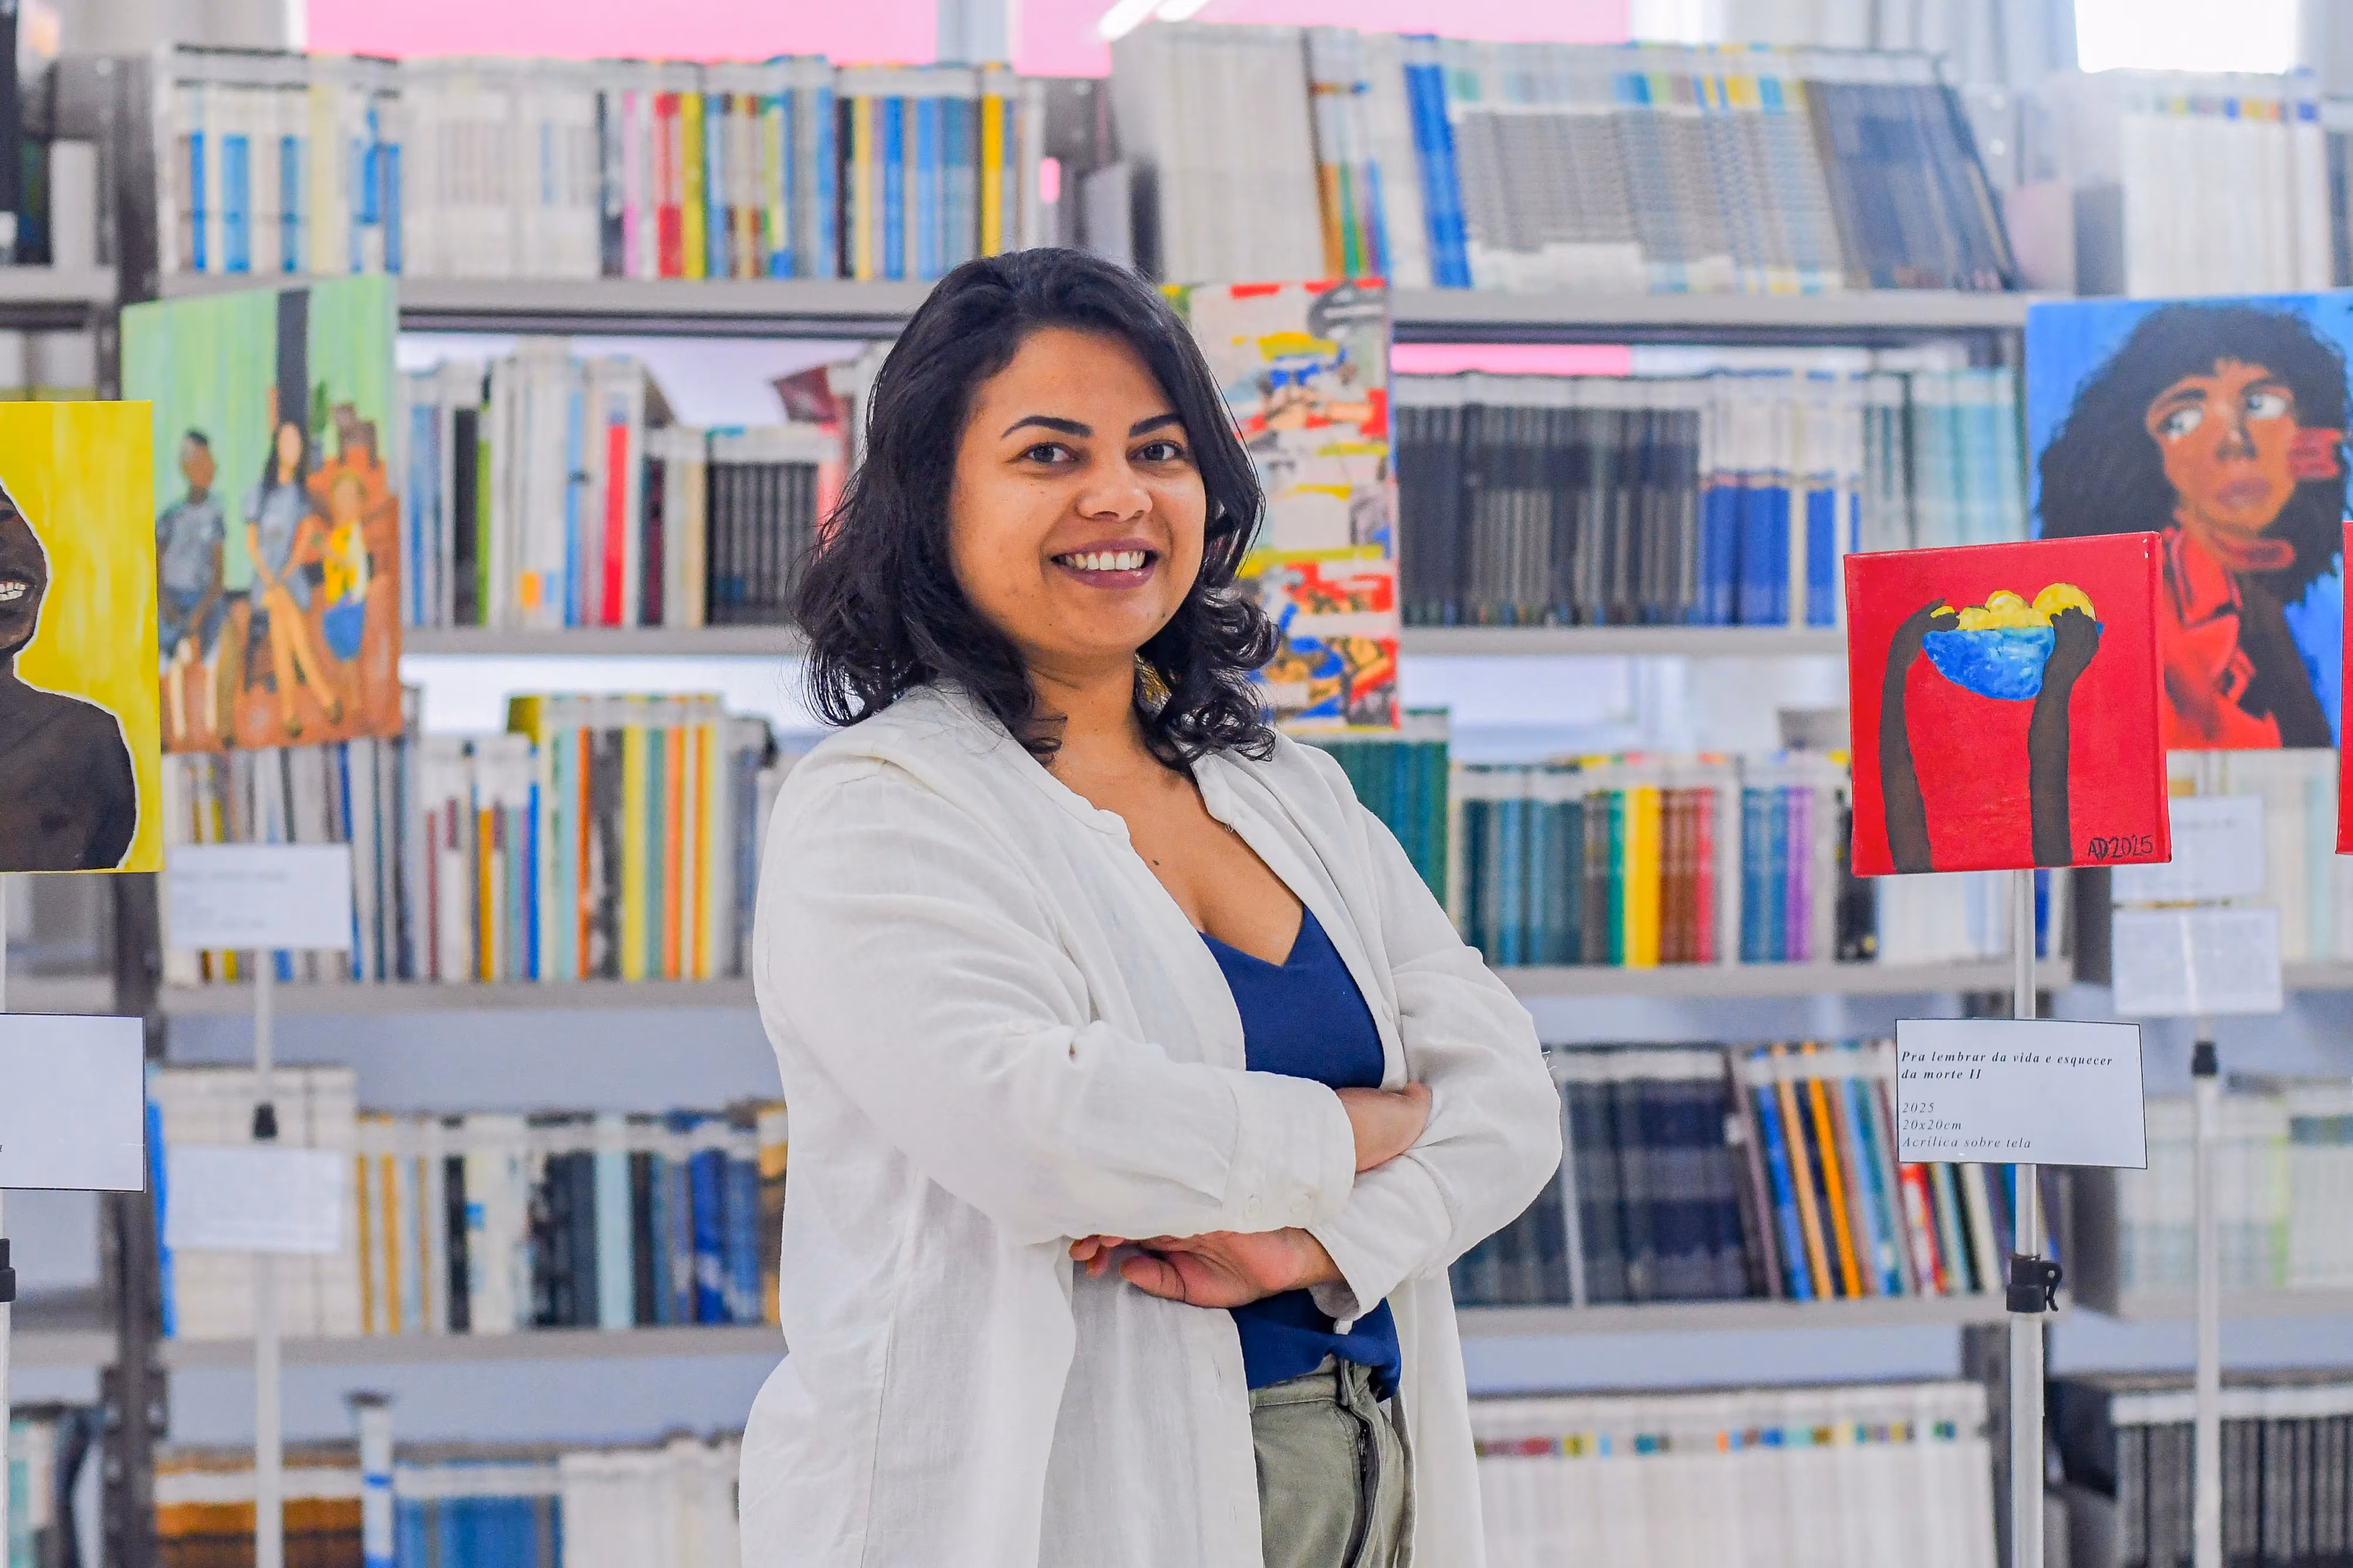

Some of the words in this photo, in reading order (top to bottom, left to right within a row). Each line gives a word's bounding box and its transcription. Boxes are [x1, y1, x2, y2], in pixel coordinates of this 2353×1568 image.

[1901, 1051, 1925, 1062] Pra
[1931, 1051, 1986, 1062] lembrar
[1992, 1051, 2007, 1062] da
[2013, 1052, 2040, 1063] vida
[2057, 1056, 2112, 1067] esquecer
[1901, 1069, 1917, 1079] da
[1923, 1070, 1963, 1079] morte
[1969, 1068, 1982, 1079] II
[1902, 1102, 1934, 1113] 2025
[1902, 1119, 1961, 1130] 20x20cm
[1902, 1136, 1958, 1147] Acrílica
[1964, 1136, 2000, 1148] sobre
[2006, 1137, 2031, 1148] tela
